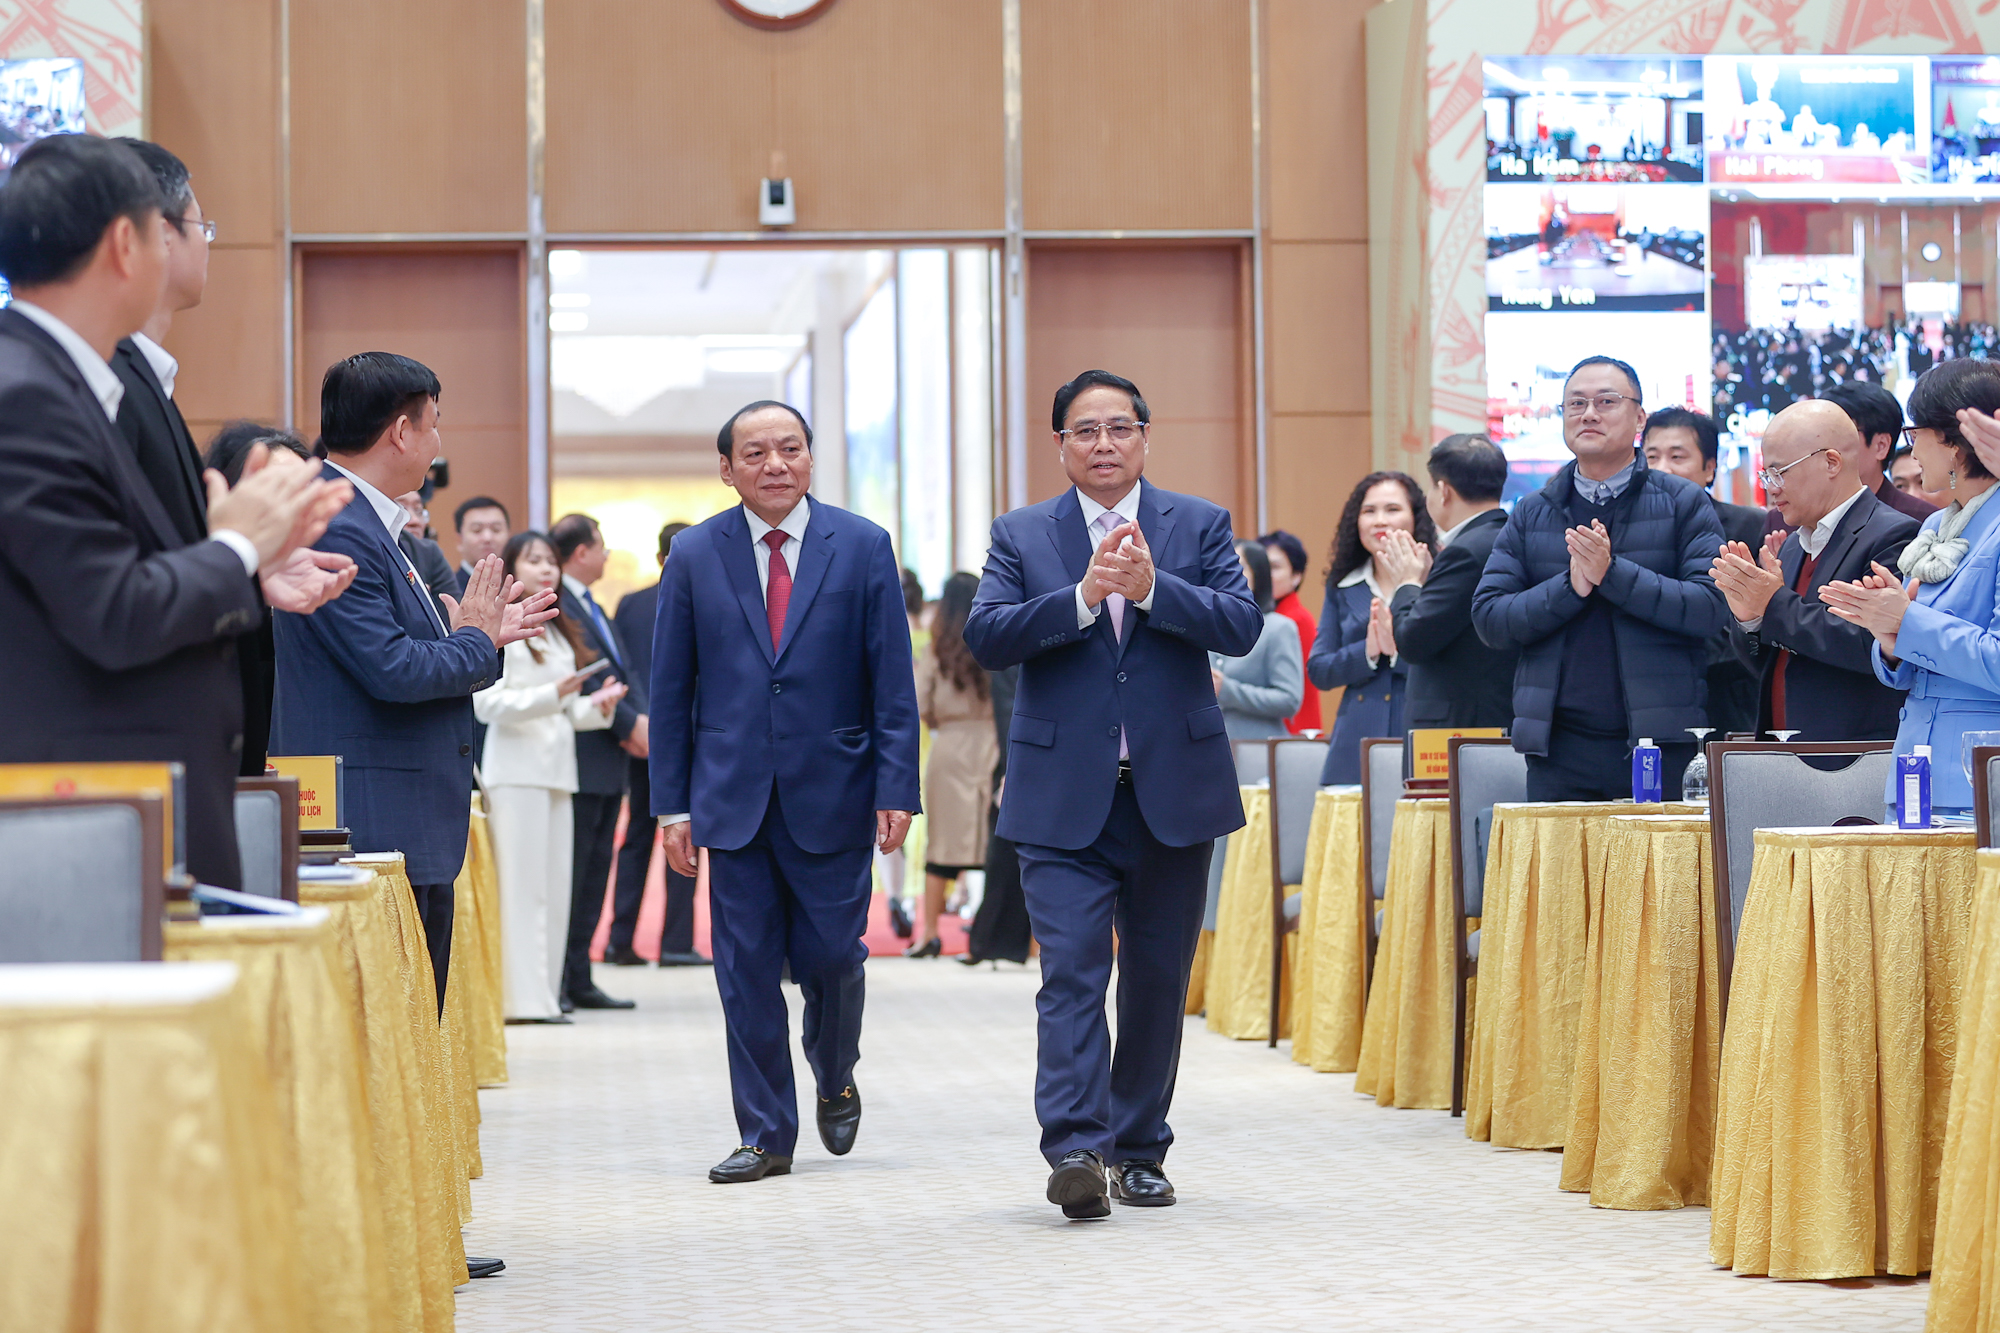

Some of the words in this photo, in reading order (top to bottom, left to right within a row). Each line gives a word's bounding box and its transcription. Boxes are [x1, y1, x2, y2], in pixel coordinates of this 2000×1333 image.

[1725, 155, 1757, 175] Hai
[1763, 155, 1824, 180] Phong
[1502, 285, 1552, 310] Hung
[1558, 284, 1595, 305] Yen
[298, 788, 316, 803] HUỘC
[307, 805, 321, 818] LỊCH
